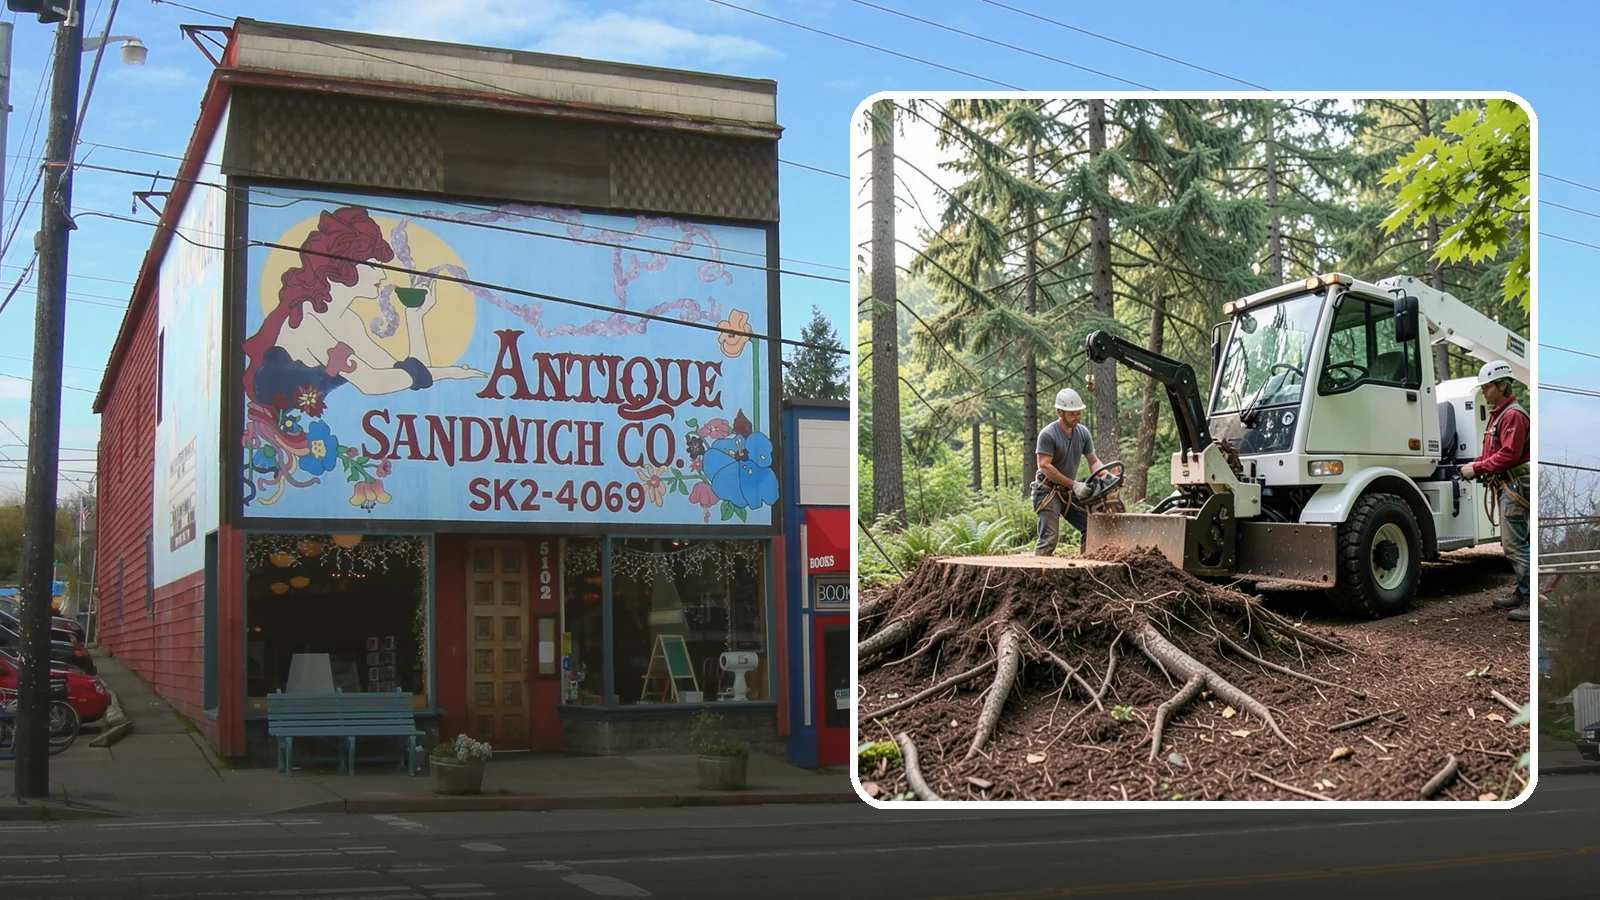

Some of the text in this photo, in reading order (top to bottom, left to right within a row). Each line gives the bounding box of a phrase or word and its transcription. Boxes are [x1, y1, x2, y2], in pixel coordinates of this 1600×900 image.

[476, 329, 723, 421] ANTIQUE
[361, 408, 686, 469] SANDWICH CO.
[468, 476, 645, 513] SK2-4069
[539, 541, 552, 600] 5102
[809, 555, 835, 569] BOOKS
